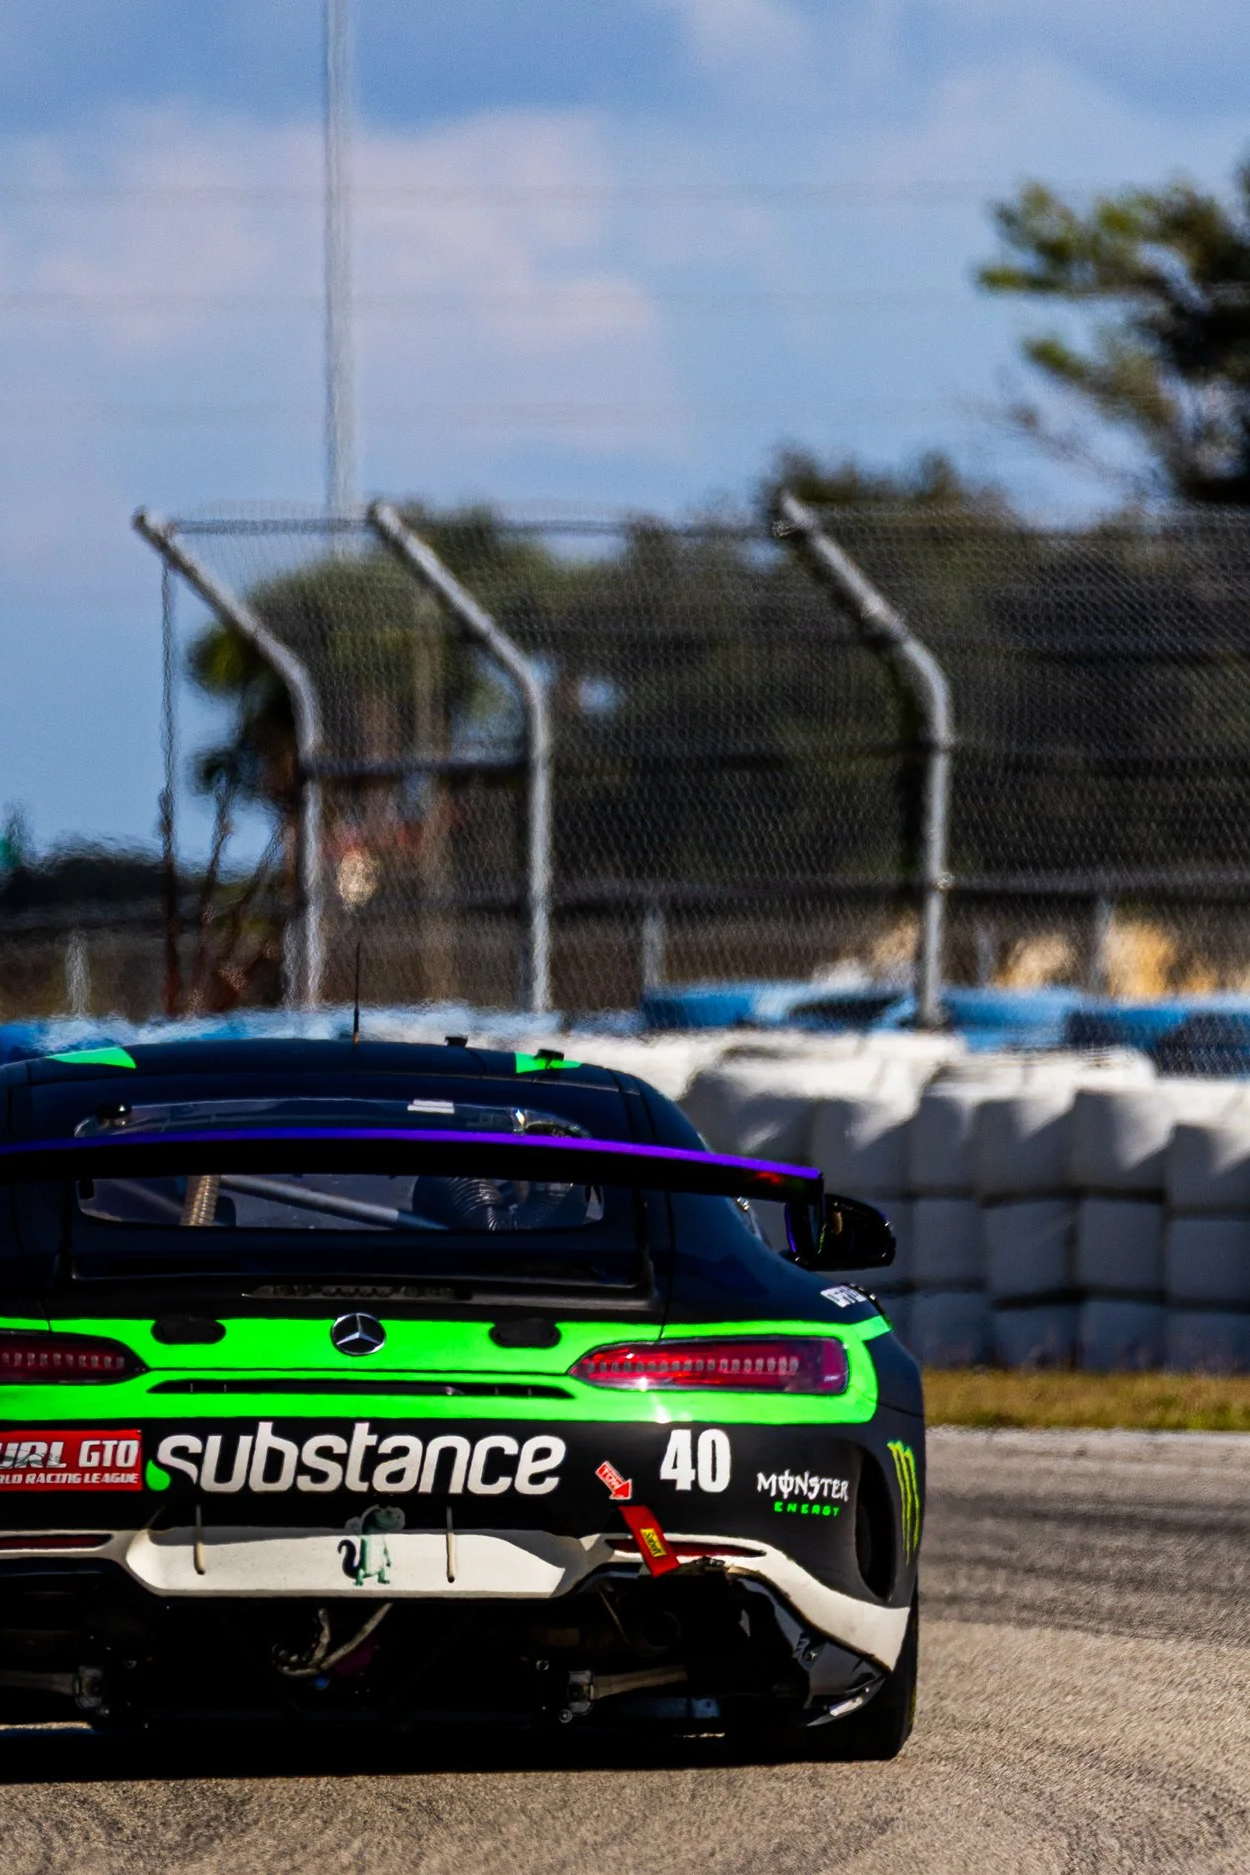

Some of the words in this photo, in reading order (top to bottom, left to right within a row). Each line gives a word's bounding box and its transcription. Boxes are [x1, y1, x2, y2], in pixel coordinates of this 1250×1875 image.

[78, 1440, 139, 1468] GTO
[156, 1421, 567, 1495] substance
[660, 1429, 731, 1492] 40
[25, 1473, 81, 1484] RACING
[83, 1472, 139, 1484] LEAGUE
[599, 1465, 624, 1491] TOW
[757, 1469, 848, 1501] MONSTER
[774, 1502, 839, 1516] ENERGY
